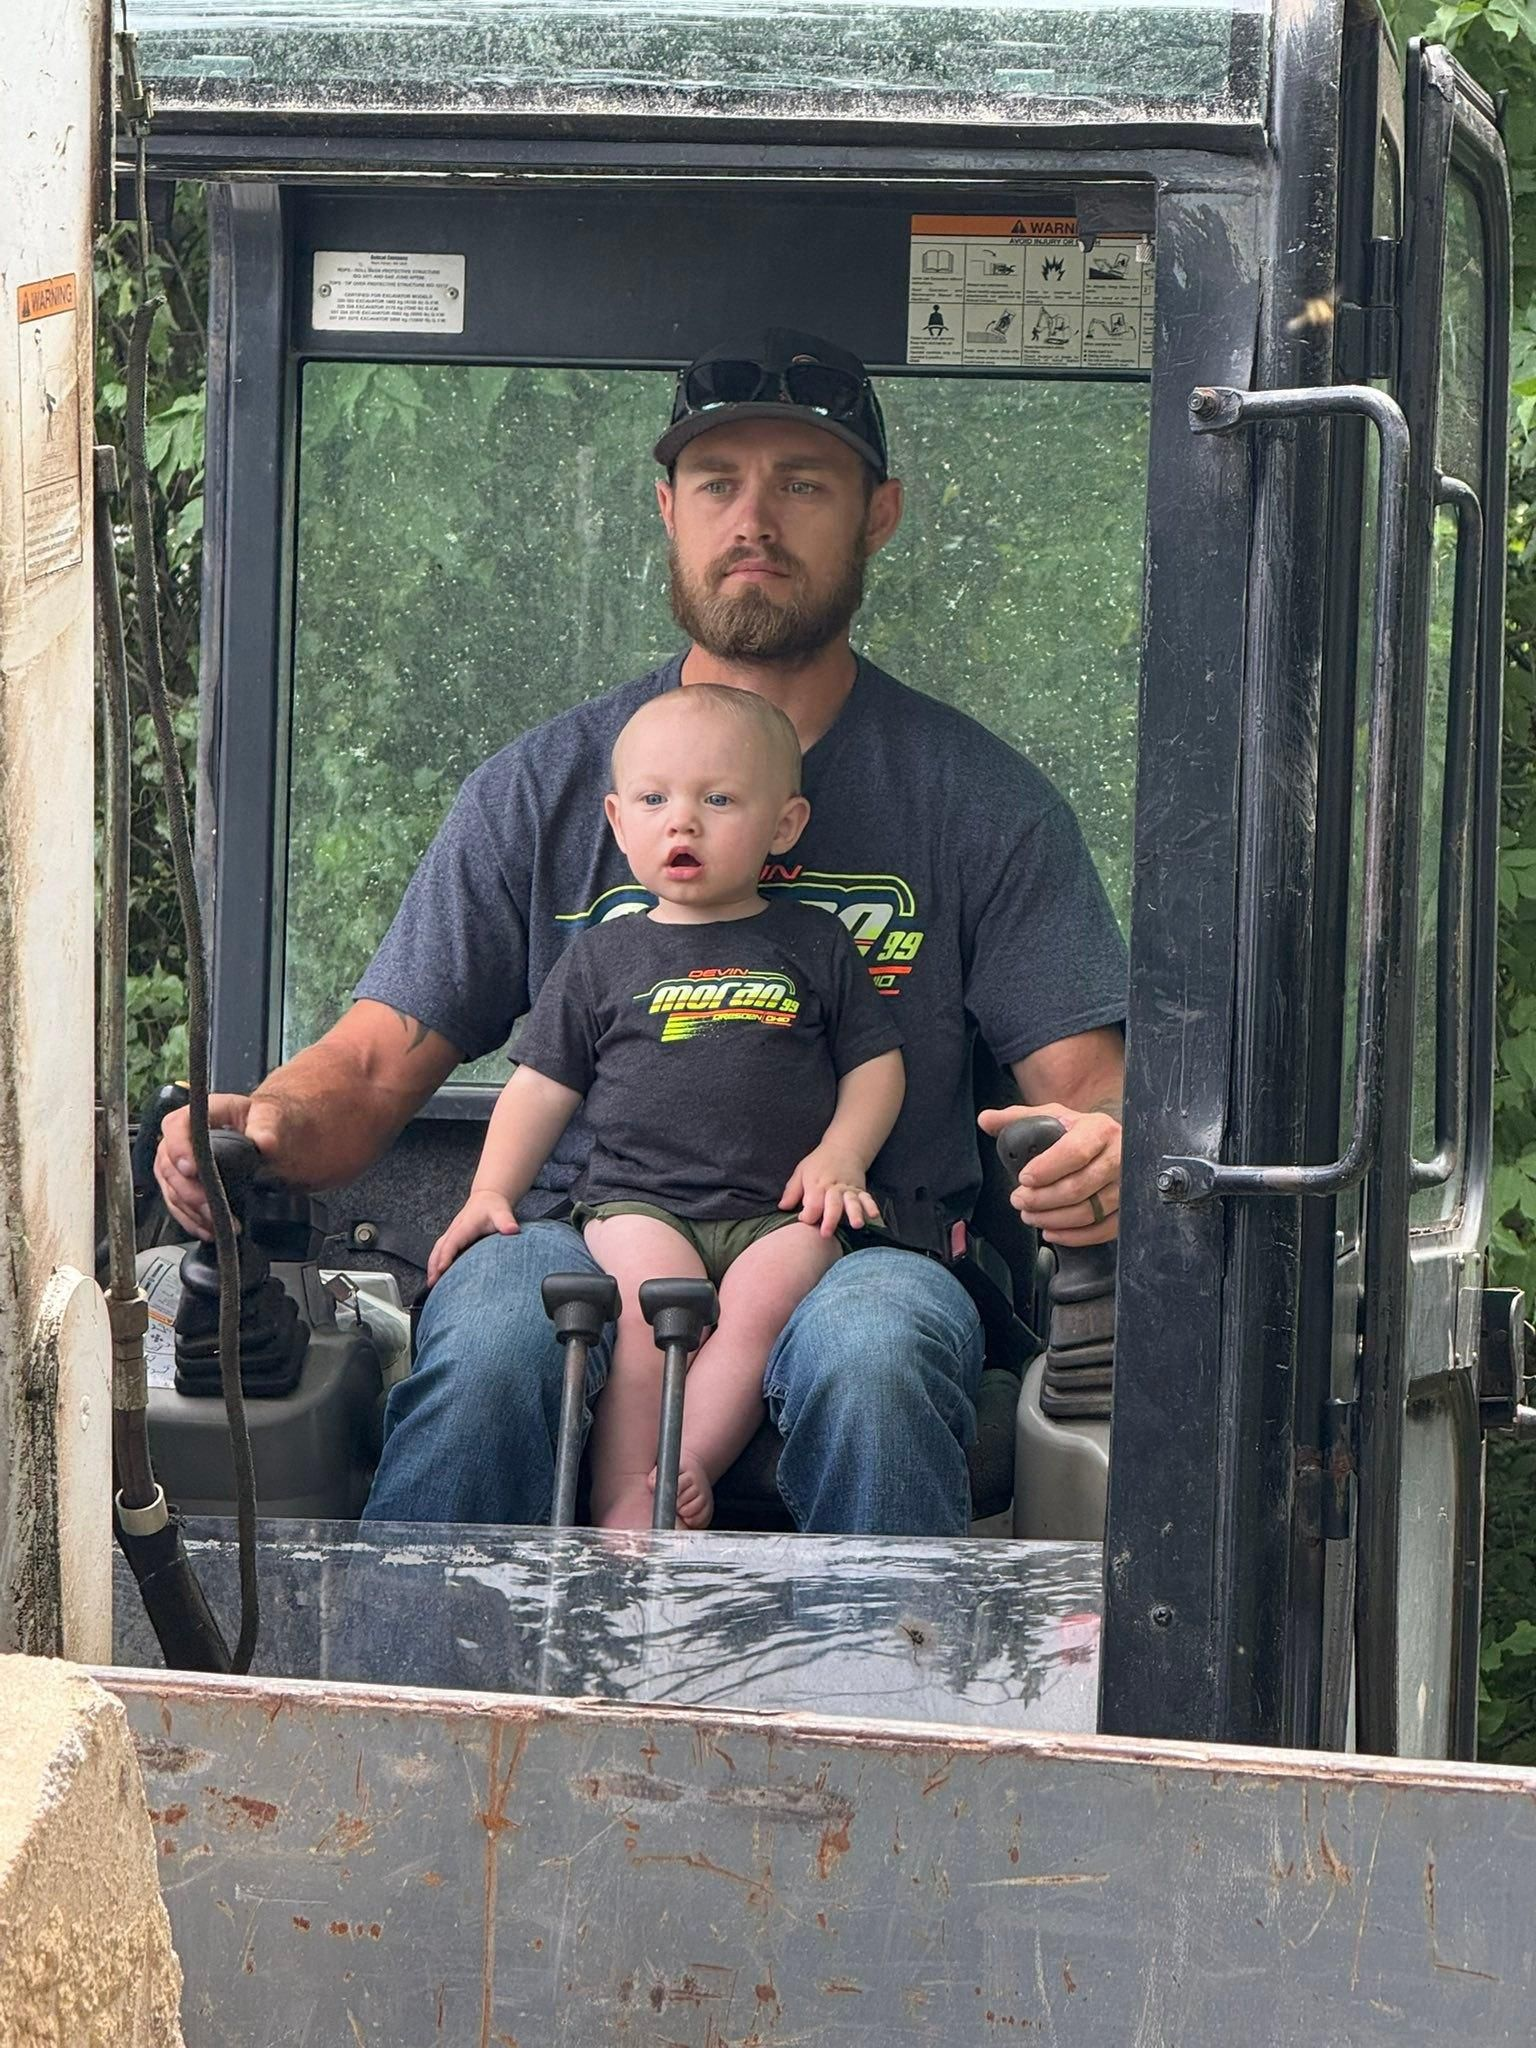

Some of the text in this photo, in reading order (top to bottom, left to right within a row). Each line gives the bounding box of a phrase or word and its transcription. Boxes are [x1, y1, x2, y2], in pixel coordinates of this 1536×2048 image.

[1030, 222, 1079, 234] WARNI
[31, 283, 73, 312] WARNING
[877, 931, 924, 961] 99
[688, 968, 749, 978] DEVIN
[648, 982, 800, 1014] moran 99
[712, 1013, 762, 1021] DRESDEN
